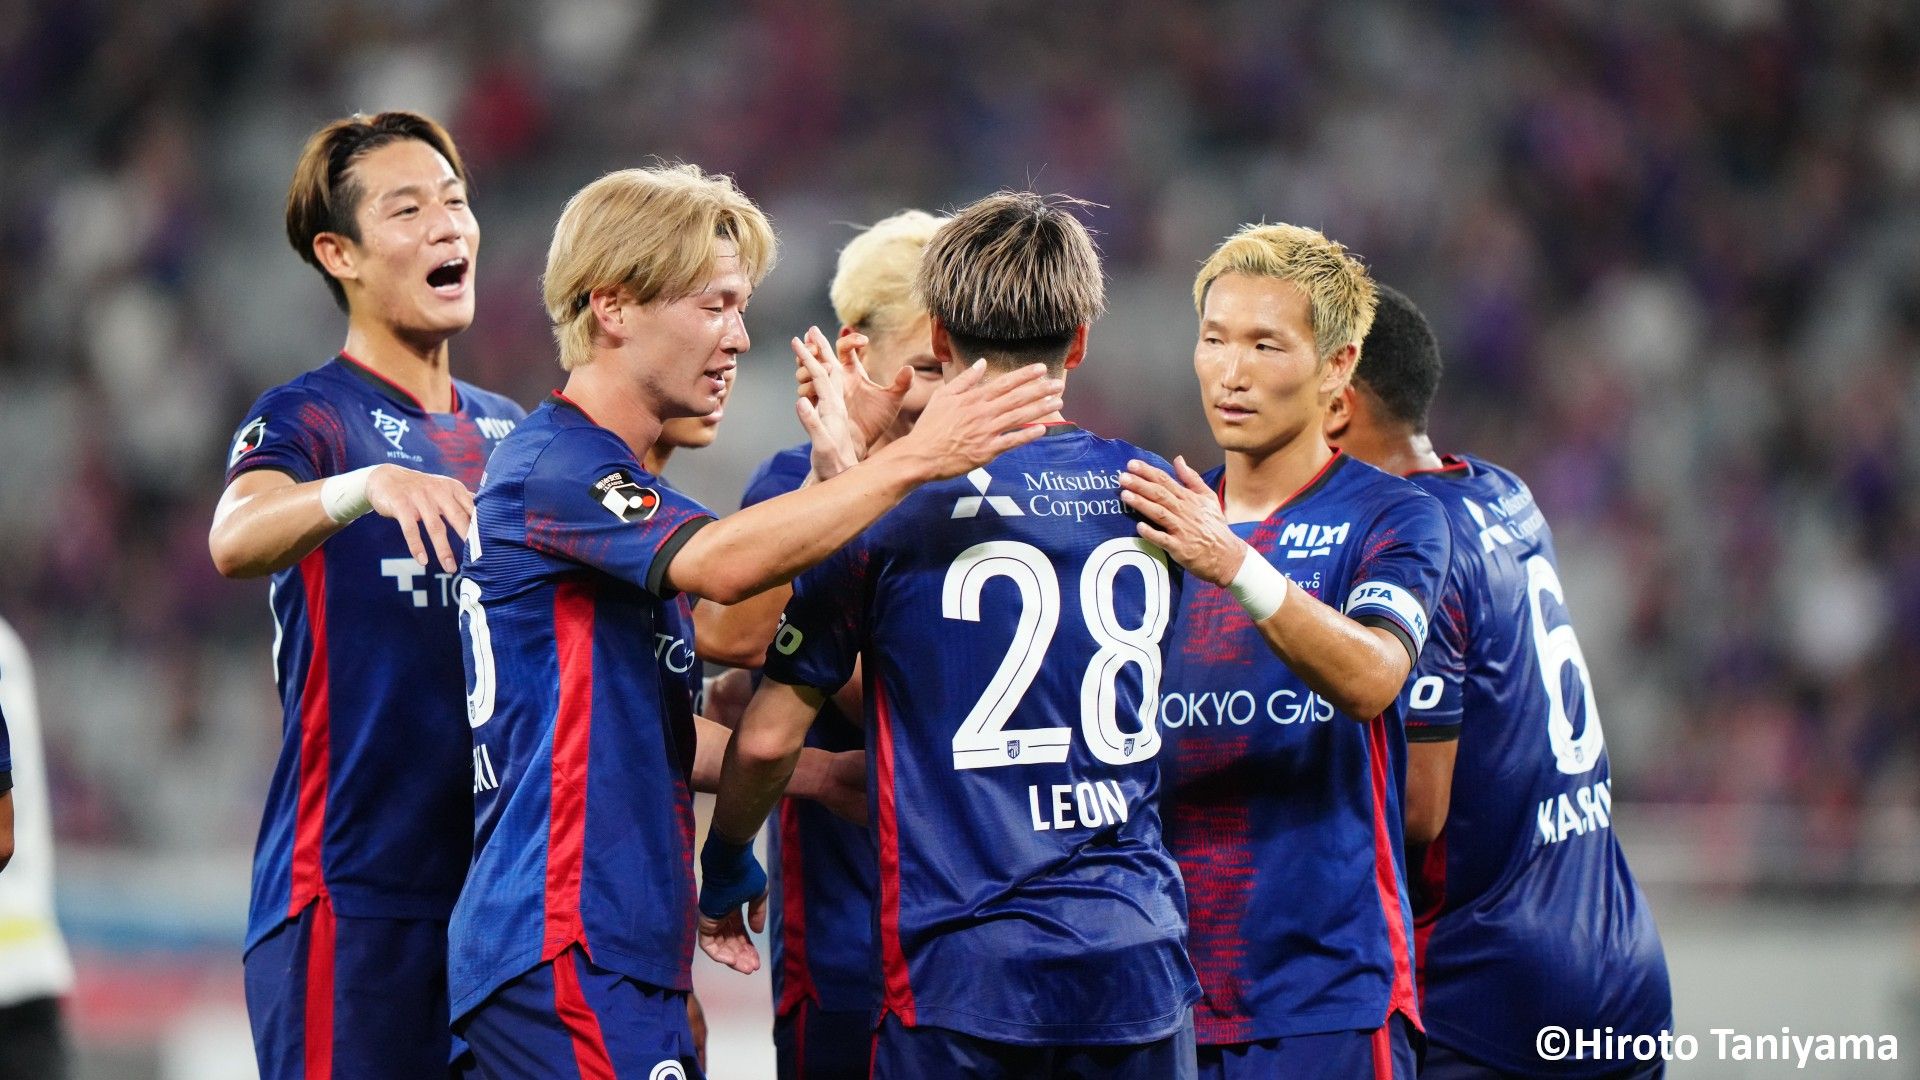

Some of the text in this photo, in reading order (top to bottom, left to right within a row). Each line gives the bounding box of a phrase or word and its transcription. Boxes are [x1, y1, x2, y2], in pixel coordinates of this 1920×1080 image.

[1021, 469, 1122, 492] Mitsubis
[1354, 587, 1393, 602] JFA
[941, 536, 1171, 770] 28
[1526, 554, 1604, 775] 6
[1161, 690, 1256, 728] OKYO
[1028, 779, 1128, 831] LEON
